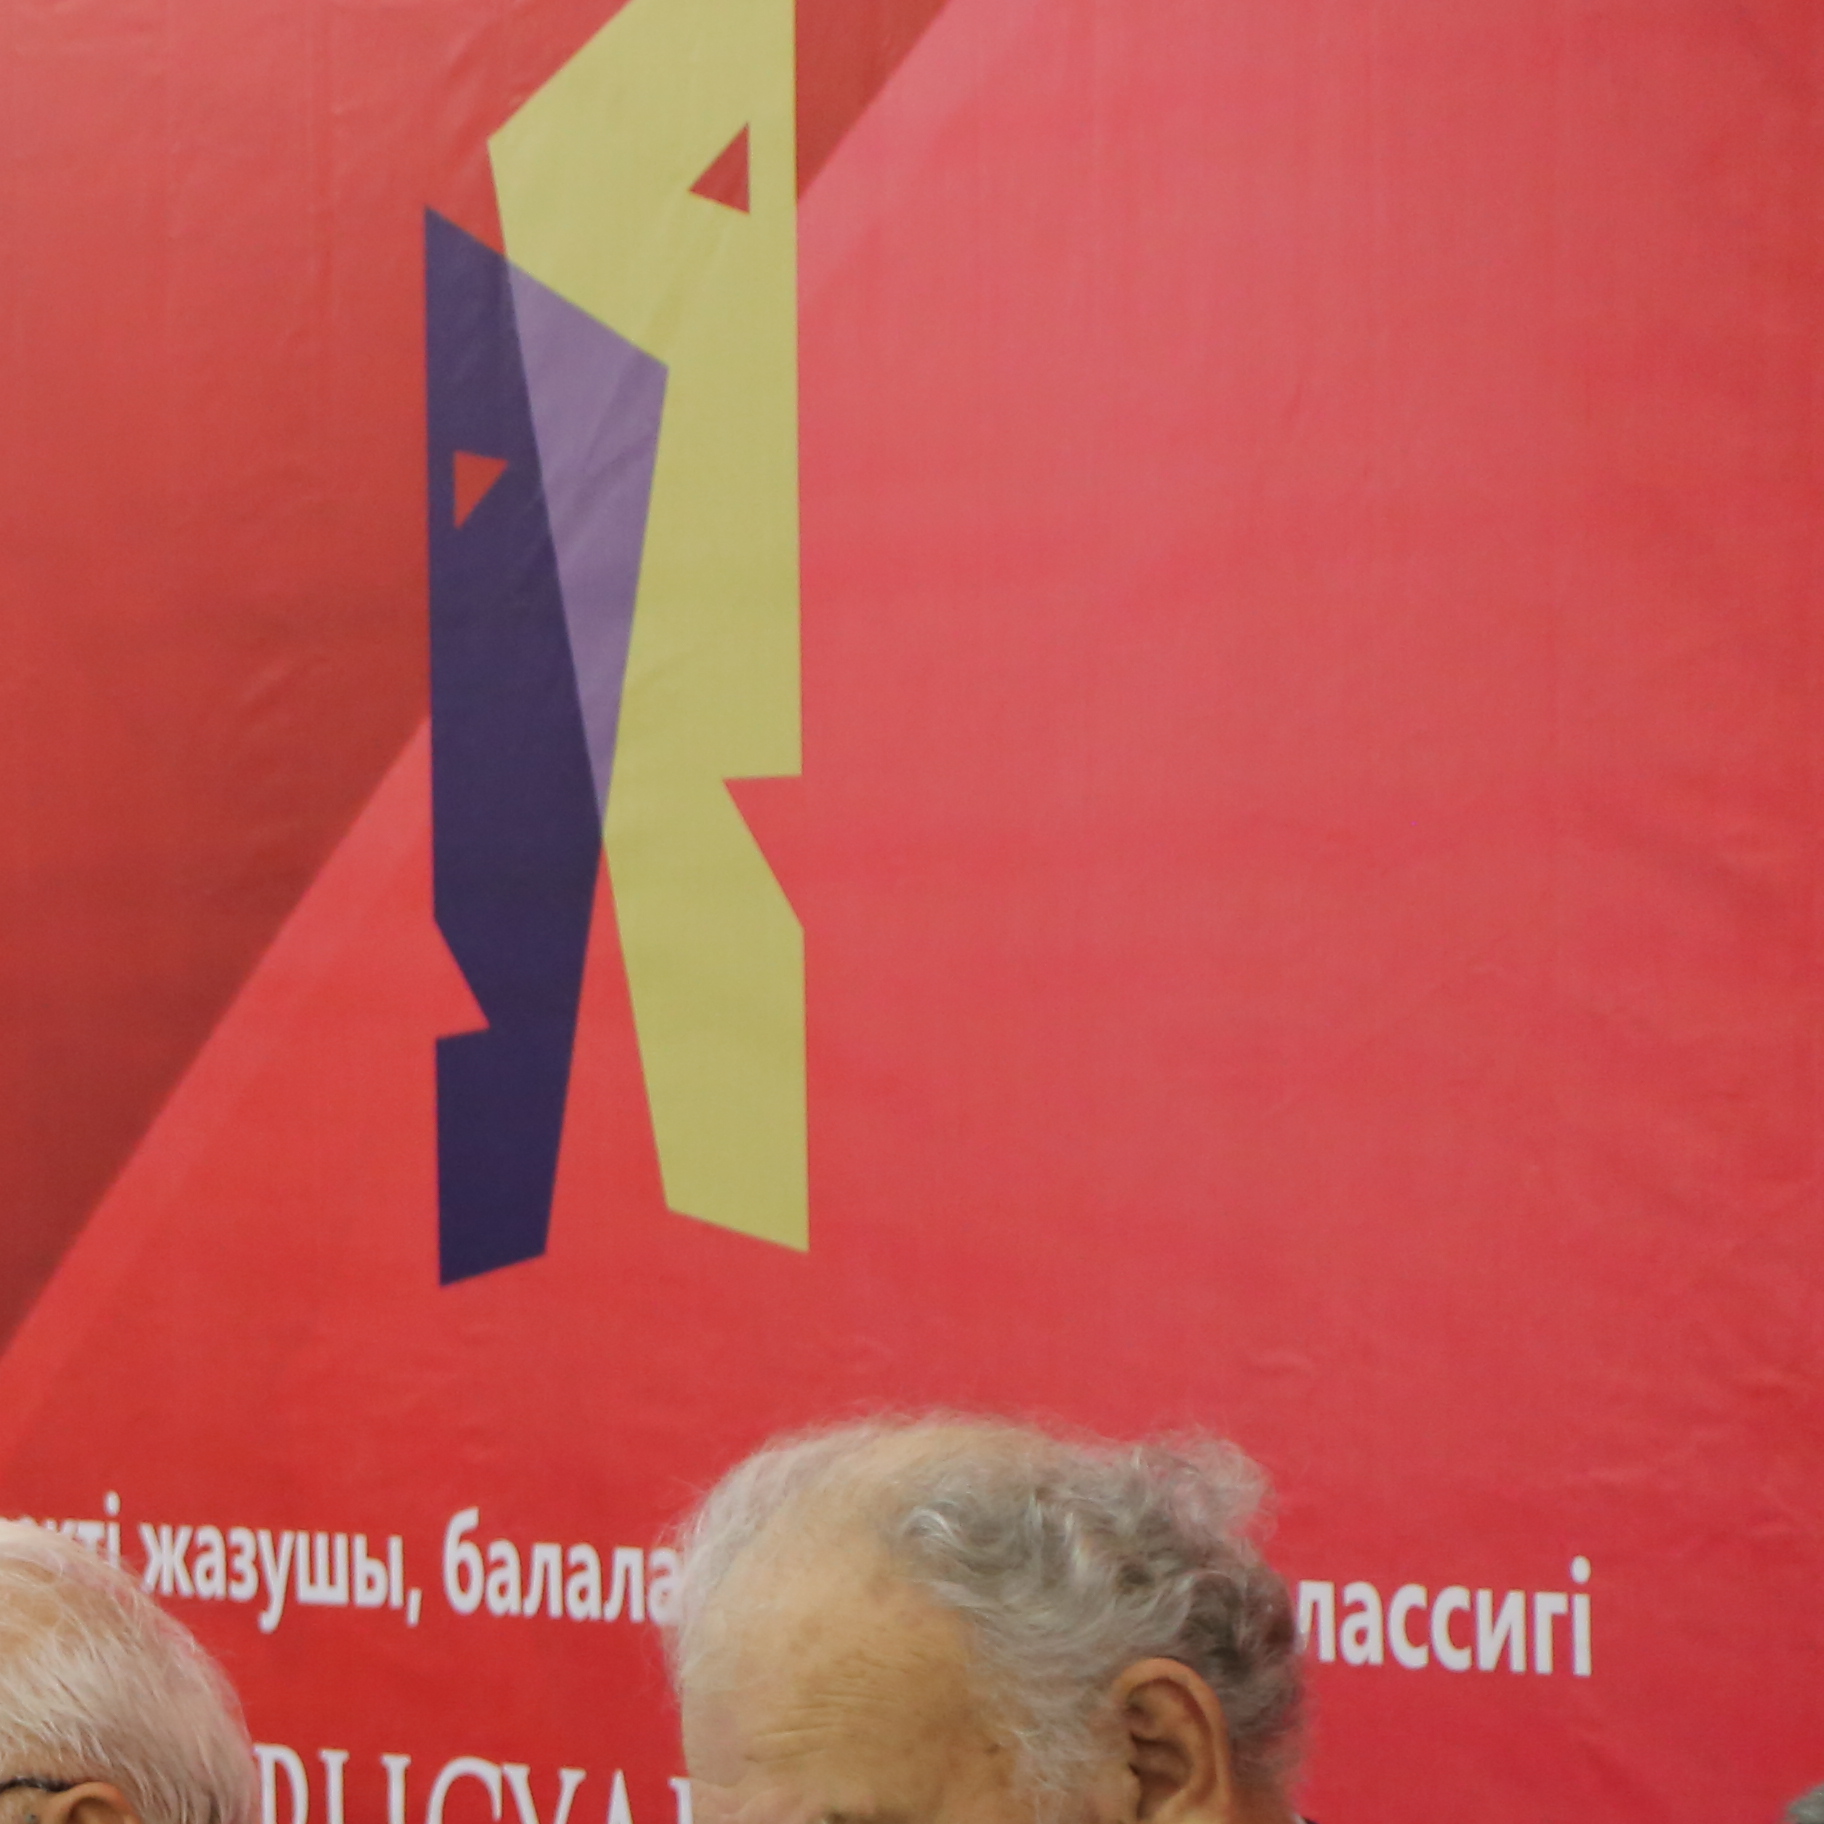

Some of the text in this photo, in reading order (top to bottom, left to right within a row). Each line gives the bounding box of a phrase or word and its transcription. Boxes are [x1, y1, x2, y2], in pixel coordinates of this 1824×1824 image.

[138, 1521, 423, 1634] жазушы,
[442, 1506, 684, 1626] балала
[1297, 1555, 1593, 1678] лассигі
